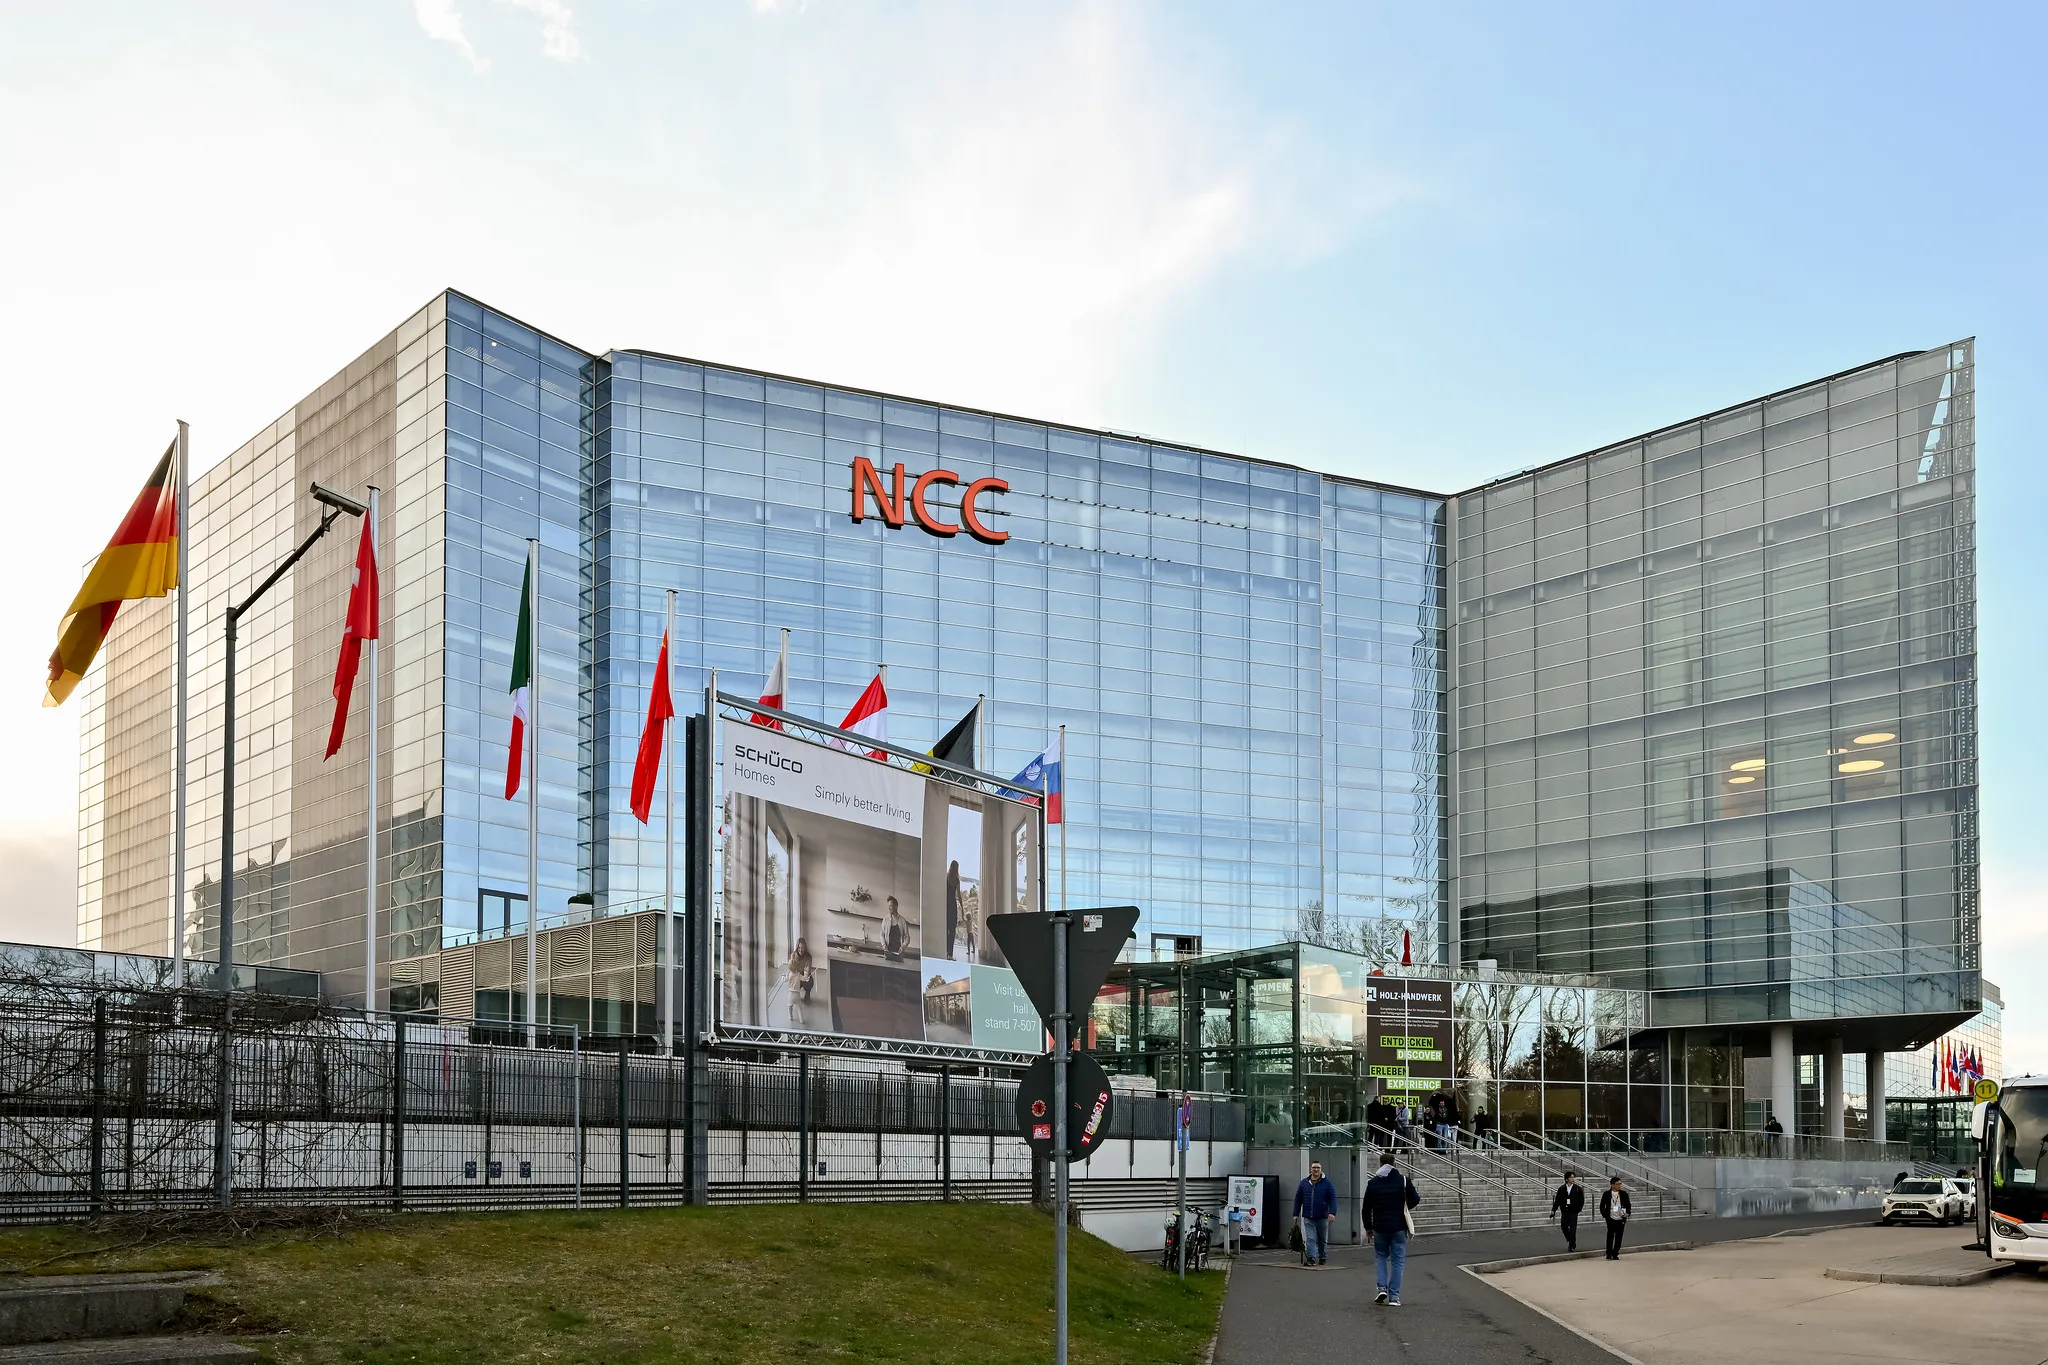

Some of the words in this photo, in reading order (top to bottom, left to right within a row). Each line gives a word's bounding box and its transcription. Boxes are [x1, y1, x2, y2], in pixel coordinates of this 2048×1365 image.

[853, 456, 1009, 544] NCC
[735, 745, 803, 774] SCHÜCO
[734, 762, 776, 786] Homes
[815, 785, 851, 807] Simply
[853, 795, 882, 813] better
[885, 803, 913, 823] living.
[993, 982, 1013, 996] Visit
[1015, 987, 1026, 998] us
[1380, 991, 1442, 1002] HOLZ-HANDWERK
[1013, 1002, 1029, 1014] hall
[985, 1018, 1010, 1030] stand
[1012, 1019, 1037, 1032] 7-507
[1381, 1037, 1432, 1047] ENTDECKEN
[1398, 1050, 1441, 1060] DISCOVER
[1387, 1079, 1441, 1089] EXPERIENCE
[1979, 1084, 1992, 1095] 11
